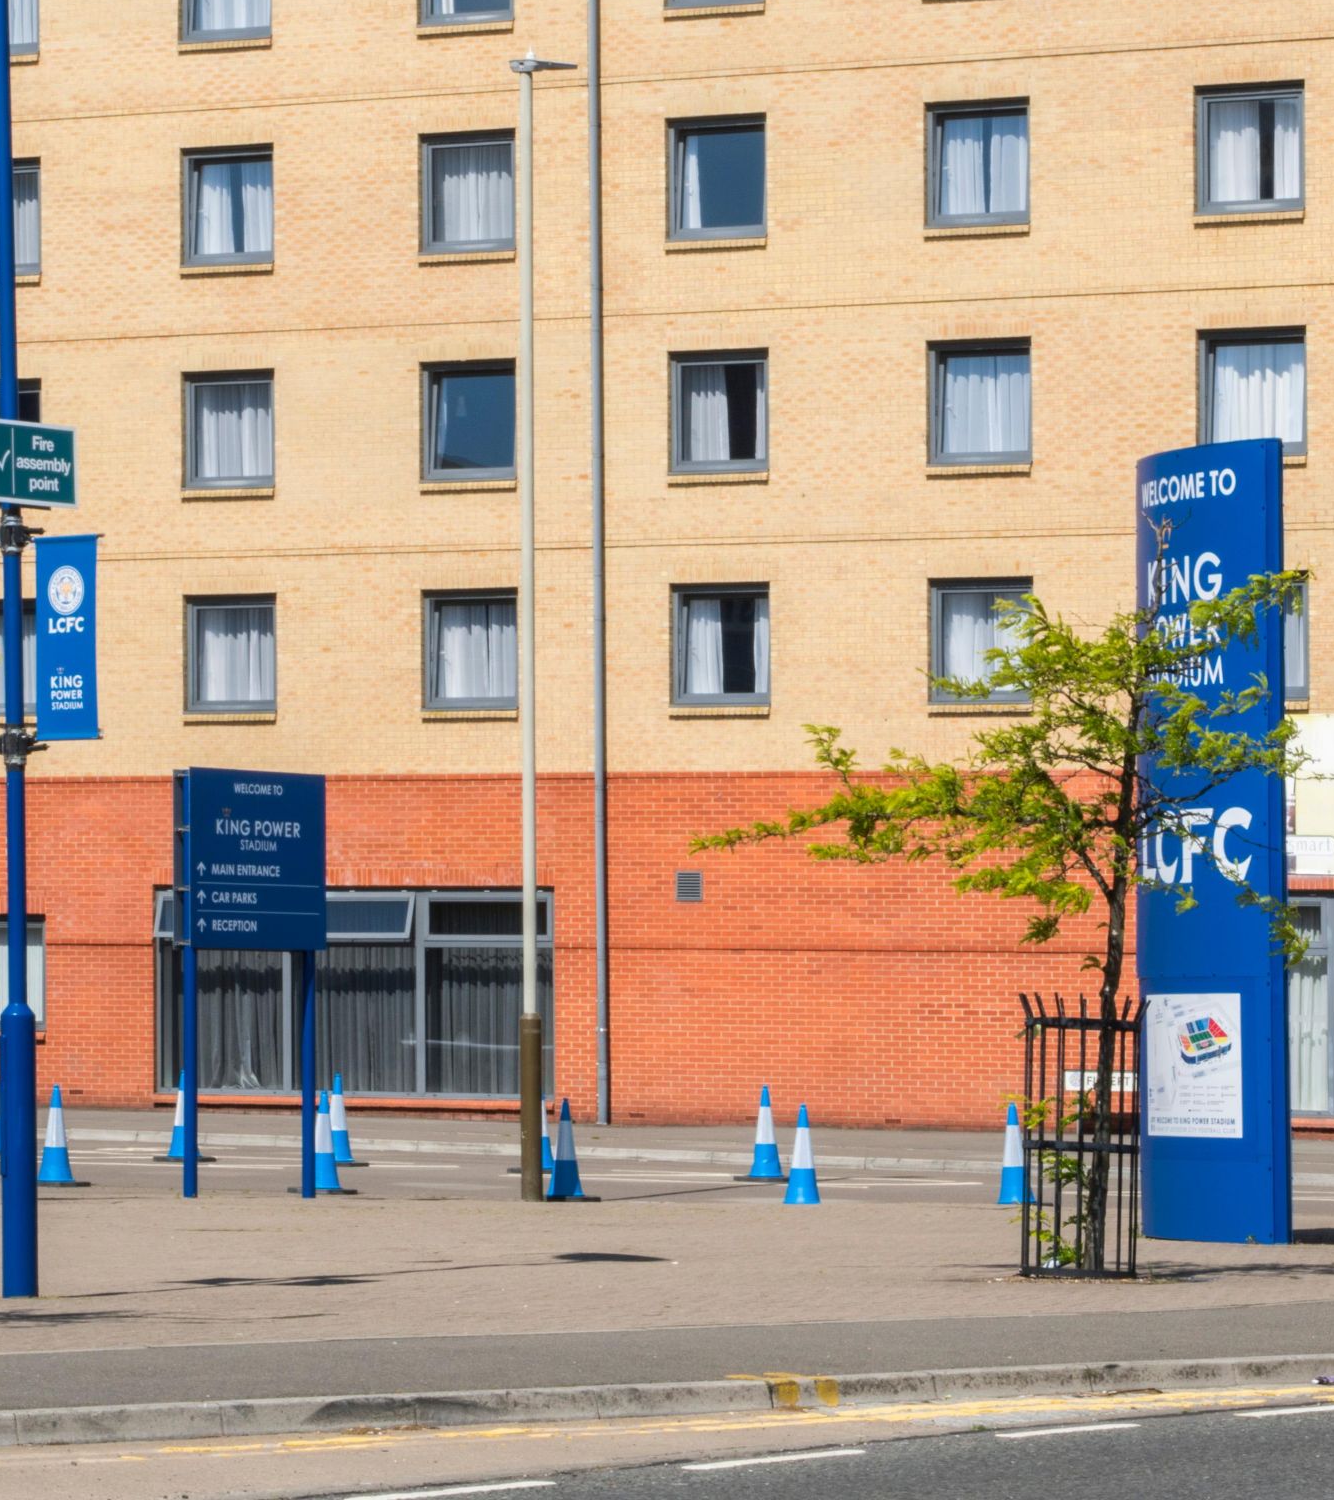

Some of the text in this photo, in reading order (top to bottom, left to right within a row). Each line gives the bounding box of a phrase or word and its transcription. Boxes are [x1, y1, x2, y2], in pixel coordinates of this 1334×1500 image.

[31, 435, 55, 452] Fire
[16, 456, 71, 476] assembly
[28, 476, 59, 492] point
[1141, 467, 1237, 509] WELCOME TO
[1147, 551, 1223, 608] KING
[48, 616, 85, 634] LCFC
[1152, 612, 1222, 648] OWER
[1148, 653, 1224, 688] ADIUM
[50, 674, 83, 689] KING
[51, 689, 82, 700] POWER
[51, 701, 83, 711] STADIUM
[233, 782, 283, 796] WELCOME TO
[215, 818, 301, 838] KING POWER
[240, 839, 278, 852] STADIUM
[1140, 806, 1253, 885] LCFC
[211, 863, 280, 877] MAIN ENTRANCE
[211, 891, 258, 904] CAR PARKS
[212, 919, 258, 932] RECEPTION
[1087, 1076, 1131, 1086] FIET
[1192, 1117, 1209, 1125] POWER
[1211, 1117, 1236, 1125] STADIUM
